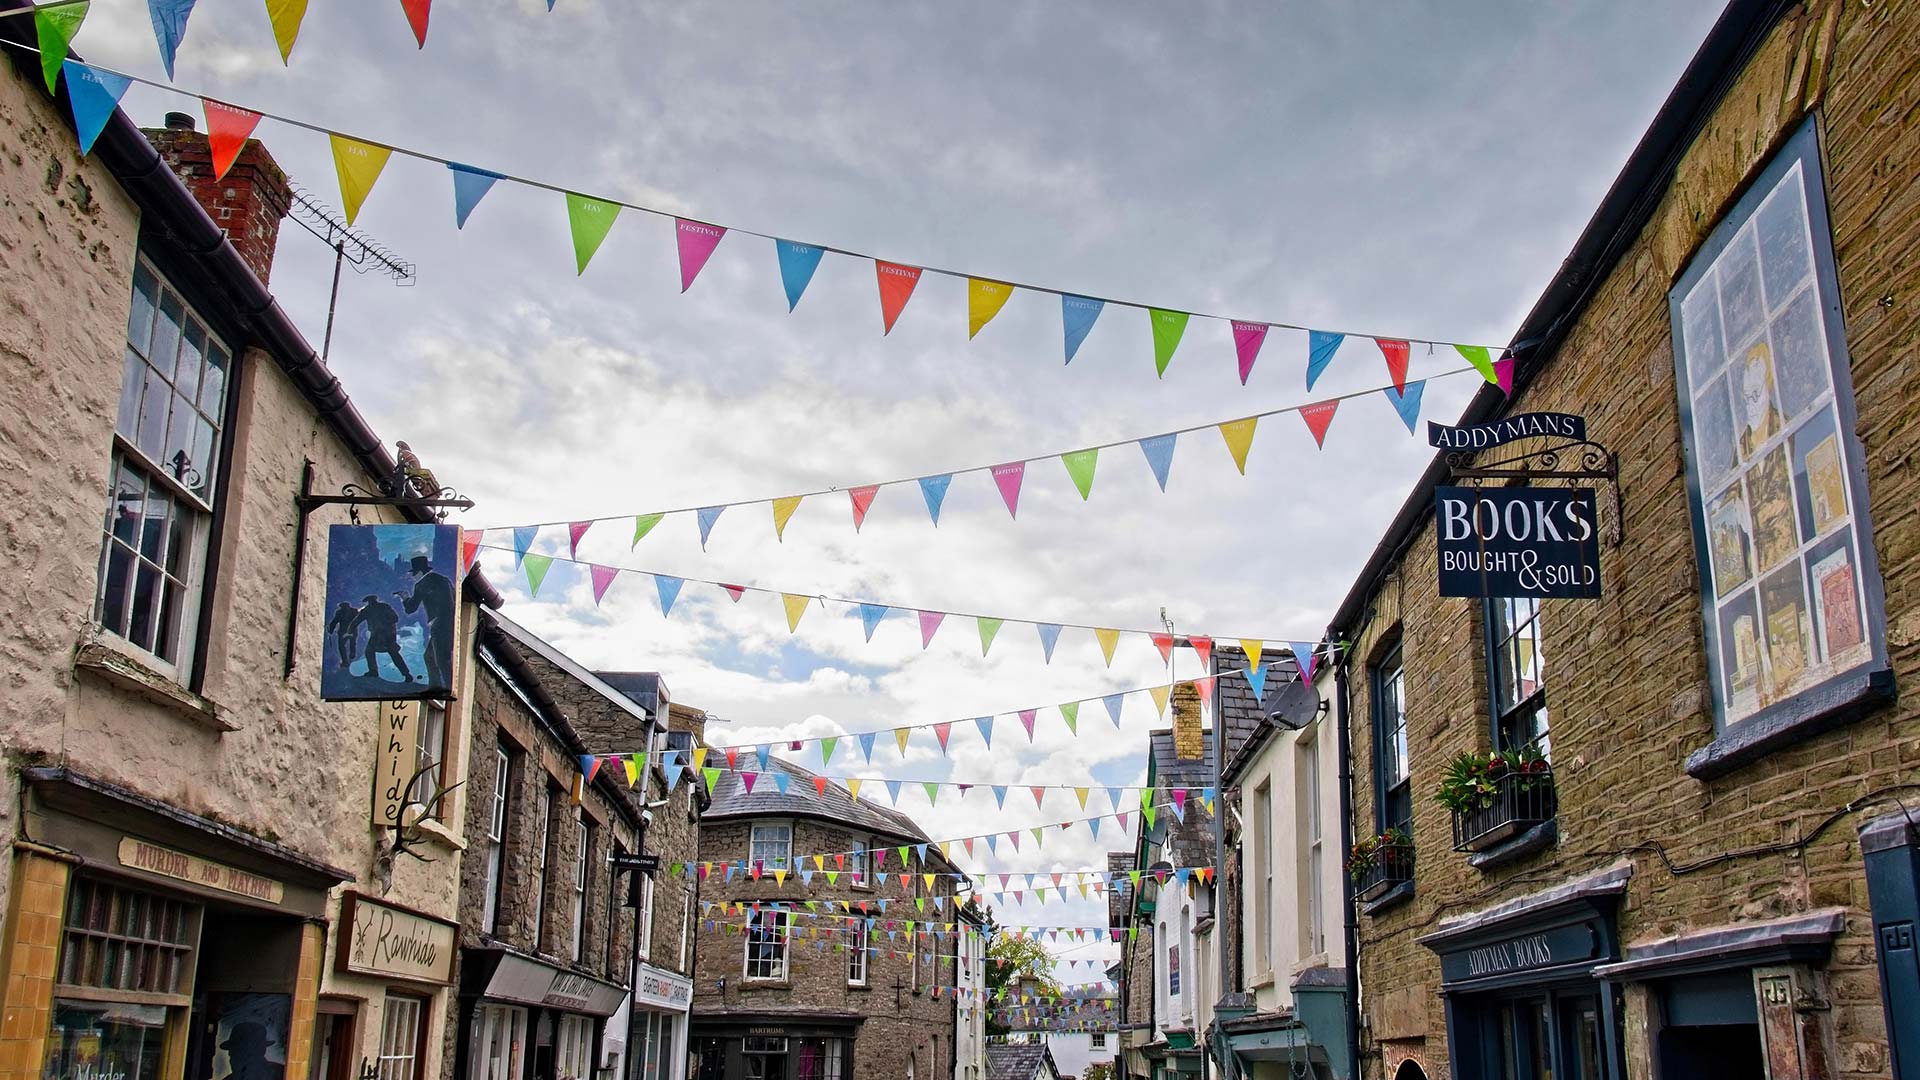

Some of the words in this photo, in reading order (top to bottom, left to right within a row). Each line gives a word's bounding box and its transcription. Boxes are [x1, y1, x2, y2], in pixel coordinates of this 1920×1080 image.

[82, 72, 105, 85] HAY
[203, 98, 254, 118] FESTIVAL
[348, 146, 369, 157] HAY
[583, 203, 602, 213] HAY
[680, 223, 720, 237] FESTIVAL
[792, 246, 808, 254] HAY
[880, 265, 917, 279] FESTIVAL
[982, 285, 998, 294] HAY
[1066, 300, 1100, 310] FESTIVAL
[1162, 315, 1176, 323] HAY
[1235, 324, 1266, 332] FESTIVAL
[1436, 416, 1575, 447] ADDYMANS
[1443, 499, 1591, 542] BOOKS
[1444, 550, 1519, 572] BOUGHT
[1518, 549, 1550, 593] &
[1546, 564, 1595, 585] SOLD
[385, 700, 408, 820] awhide
[134, 843, 189, 879] MURDER
[201, 864, 220, 884] AND
[226, 869, 273, 900] MAYHEM
[372, 909, 436, 968] Rawhide
[1468, 943, 1512, 976] ADDYMAN
[1513, 935, 1551, 968] BOOKS
[77, 1061, 125, 1080] Murder
